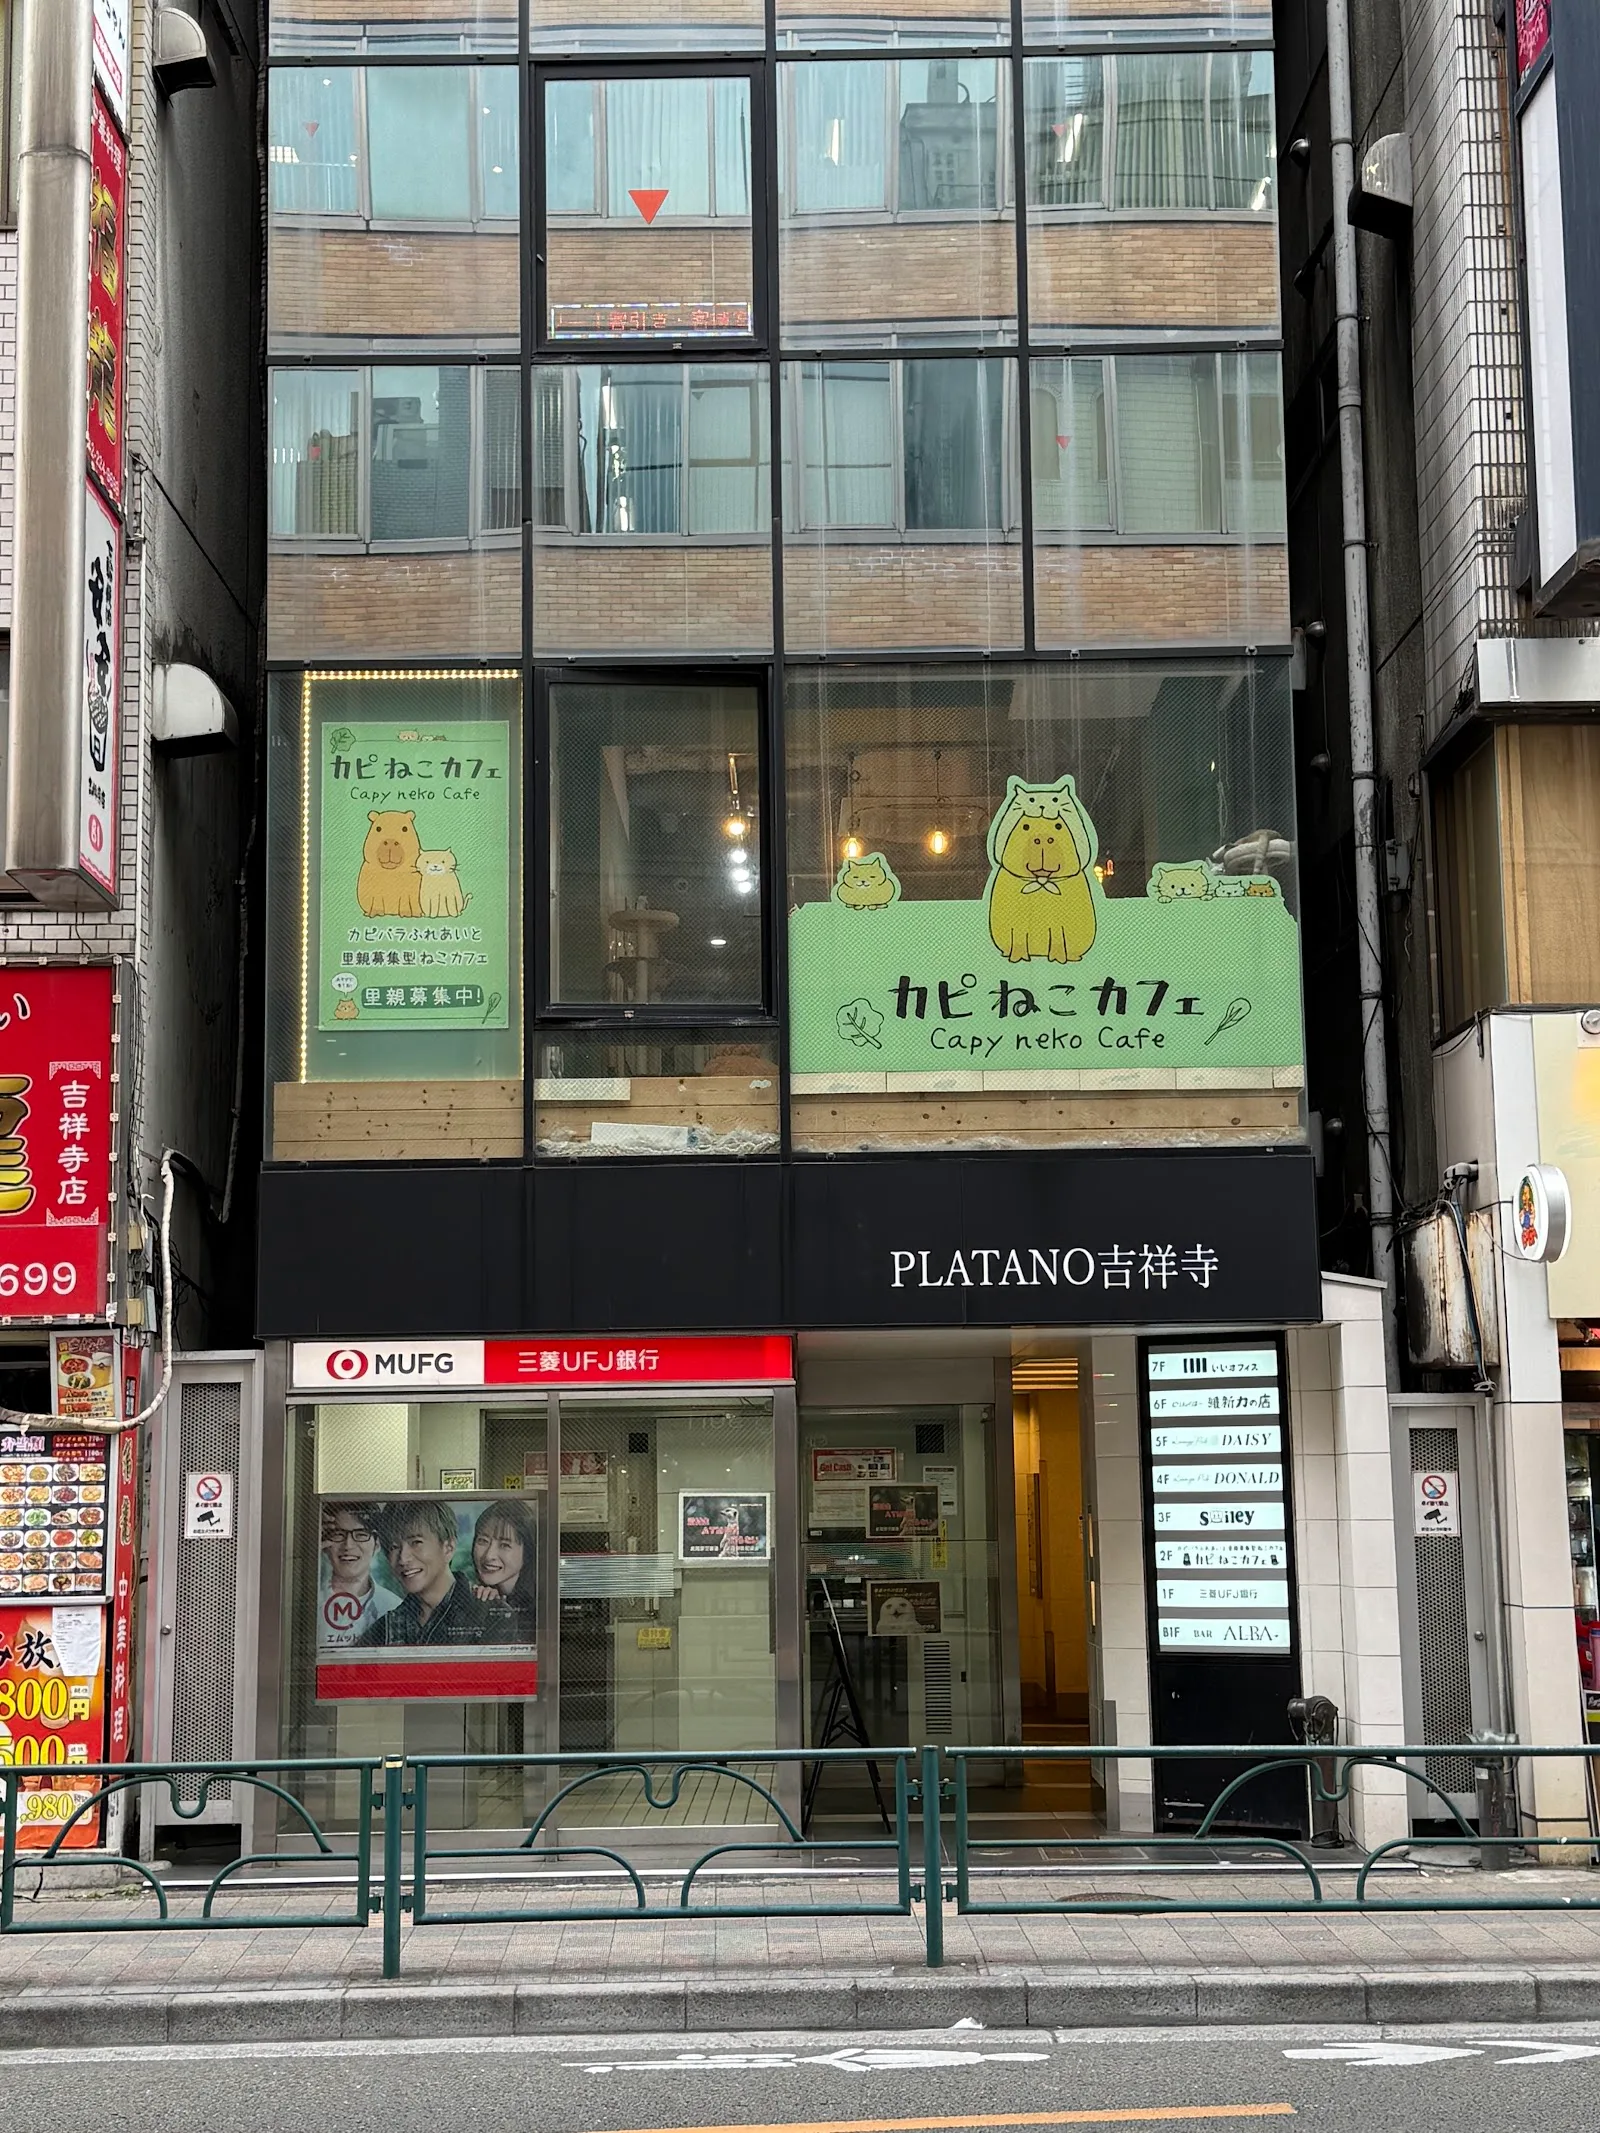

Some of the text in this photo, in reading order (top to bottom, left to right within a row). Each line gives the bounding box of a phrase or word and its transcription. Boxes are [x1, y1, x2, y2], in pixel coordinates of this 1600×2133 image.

[330, 753, 503, 780] カピねこカフェ
[350, 786, 480, 804] Capy neko Cafe
[347, 926, 482, 942] カピバラふれあいと
[340, 950, 489, 967] 里親募集型ねこカフェ
[362, 985, 483, 1007] 里親募集中!
[887, 973, 1205, 1019] カピねこカフェ
[929, 1025, 1166, 1058] Capy neko Cafe
[57, 1080, 91, 1206] 吉祥寺店
[889, 1243, 1220, 1290] PLATANO吉祥寺
[374, 1352, 455, 1376] MUFG
[517, 1348, 661, 1374] 三菱UFJ銀行
[1152, 1361, 1259, 1373] 7F いいオフィス
[1153, 1399, 1167, 1409] 6F
[1207, 1393, 1271, 1409] 維新力の店
[1155, 1436, 1168, 1447] 5F
[1222, 1432, 1272, 1446] DAISY
[1156, 1474, 1169, 1485] 4F
[1214, 1471, 1280, 1485] DONALD
[1158, 1512, 1171, 1522] 3F
[1160, 1550, 1173, 1561] 2F
[1162, 1588, 1258, 1600] 1F 三菱UFJ銀行
[1163, 1627, 1180, 1638] B1F
[1194, 1629, 1213, 1638] BAR
